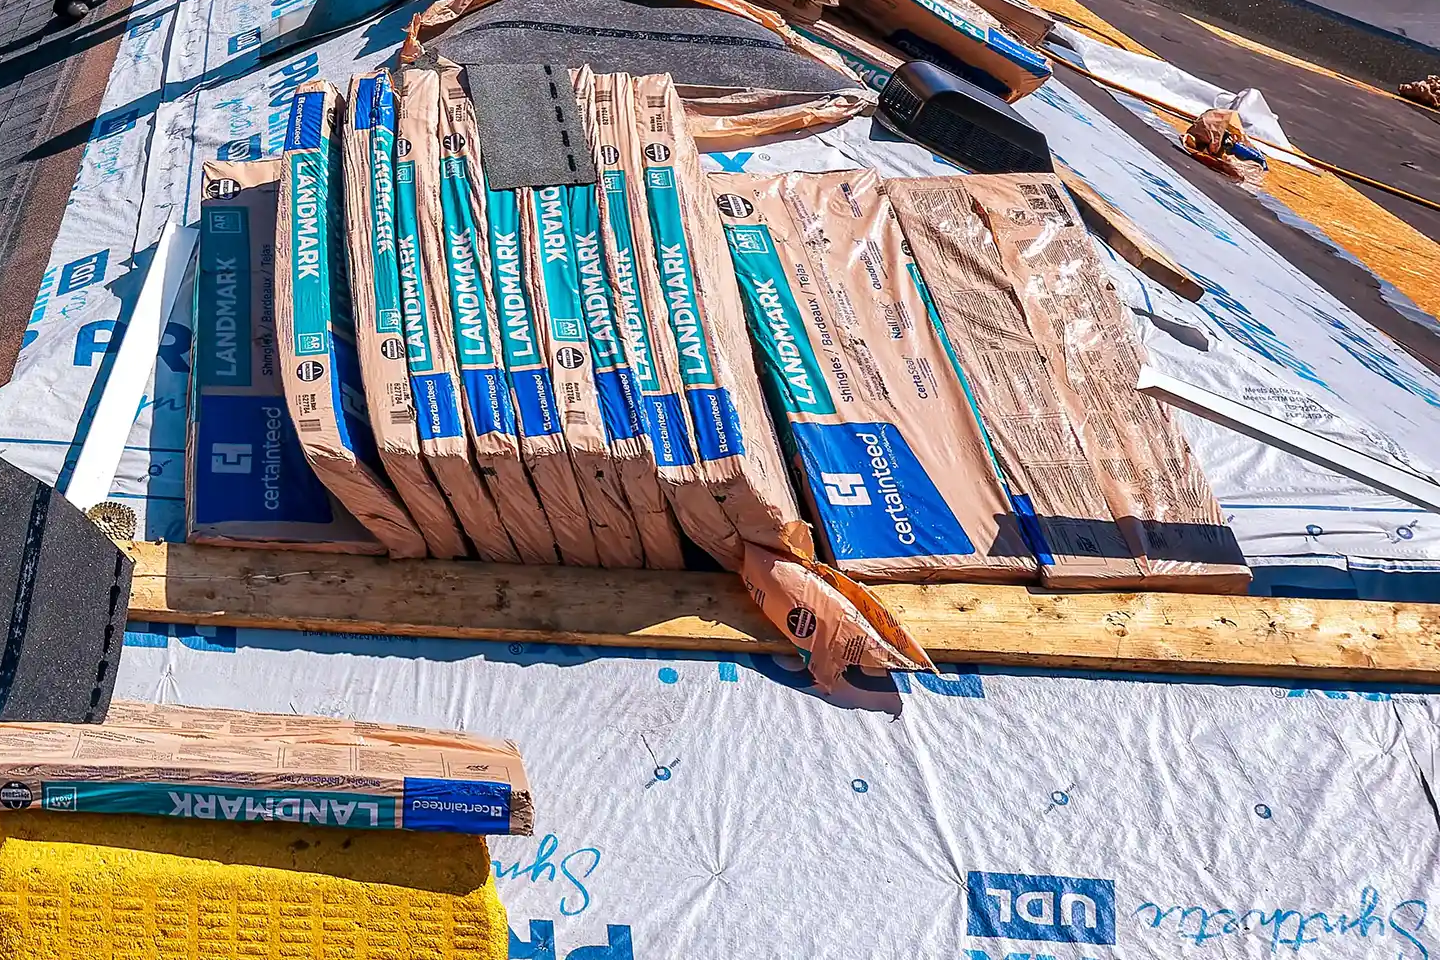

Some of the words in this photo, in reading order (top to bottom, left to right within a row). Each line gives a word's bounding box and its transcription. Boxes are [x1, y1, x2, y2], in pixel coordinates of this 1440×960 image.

[294, 101, 306, 146] certainteed
[650, 171, 662, 185] AR
[214, 215, 225, 229] AR
[296, 162, 320, 280] LANDMARK
[539, 187, 568, 263] DMARK
[261, 243, 272, 266] Tejas
[794, 262, 811, 290] Tejas
[261, 277, 272, 322] Bardeaux
[398, 234, 427, 363] LANDMARK
[450, 227, 487, 355] LANDMARK
[494, 230, 535, 357] LANDMARK
[575, 230, 619, 357] LANDMARK
[660, 242, 708, 375] LANDMARK
[215, 256, 237, 377] LANDMARK
[567, 323, 576, 336] AR
[809, 297, 834, 346] Bardeaux
[882, 301, 904, 342] NailTrak
[262, 331, 272, 376] Shingles
[311, 336, 321, 349] AR
[754, 277, 817, 406] LANDMARK
[484, 374, 500, 426] certainteed
[532, 374, 551, 423] certainteed
[830, 355, 854, 403] Shingles
[901, 356, 929, 400] CertaSeal
[425, 380, 441, 427] certainteed
[653, 401, 672, 455] certainteed
[709, 394, 727, 446] certainteed
[262, 406, 282, 510] certainteed
[855, 432, 916, 545] certainteed
[167, 790, 380, 827] LANDMARK
[412, 799, 491, 813] certainteed
[985, 887, 1097, 929] UDL
[1136, 883, 1429, 960] Synthetic
